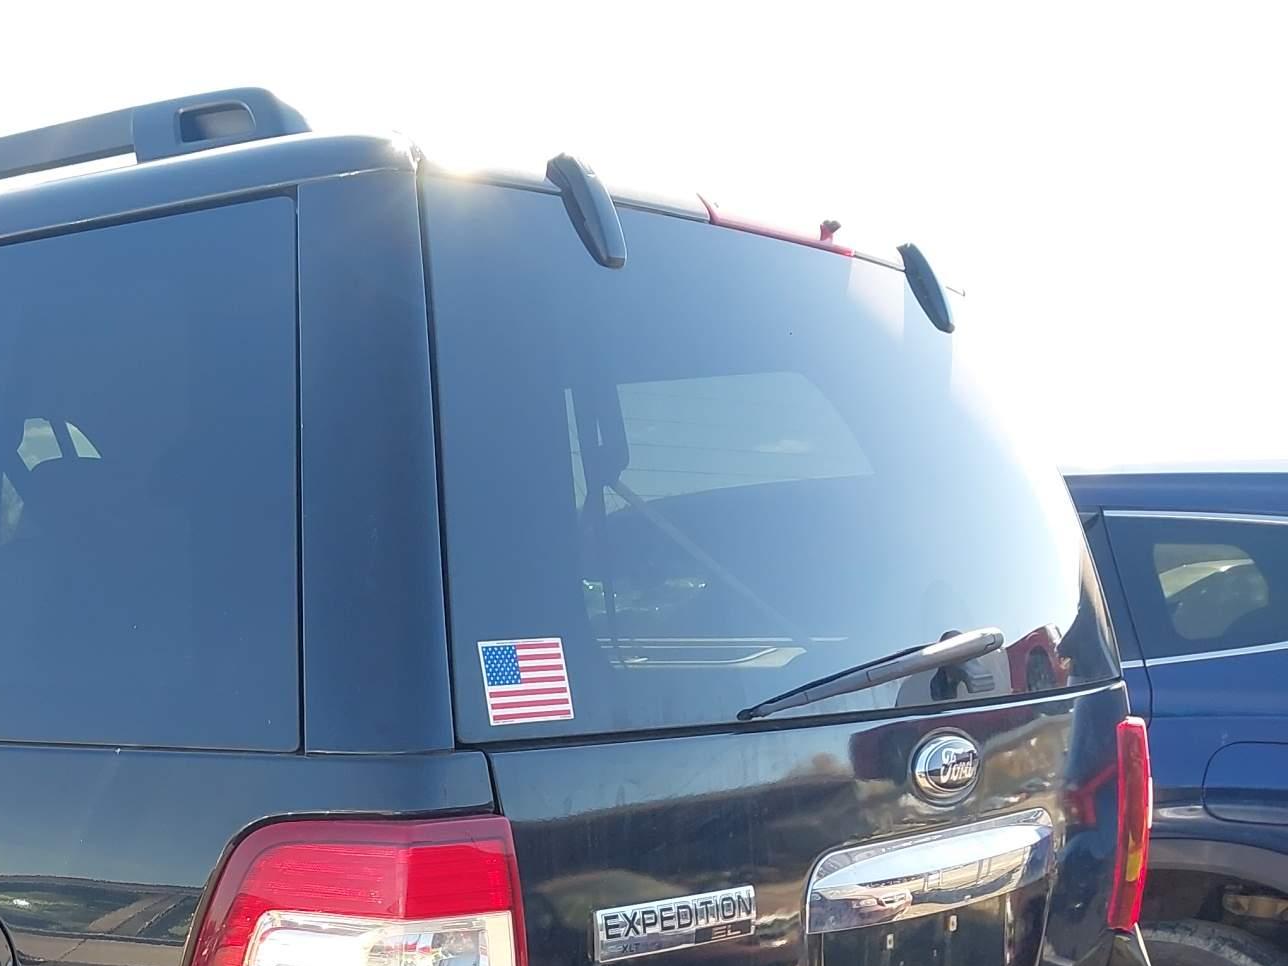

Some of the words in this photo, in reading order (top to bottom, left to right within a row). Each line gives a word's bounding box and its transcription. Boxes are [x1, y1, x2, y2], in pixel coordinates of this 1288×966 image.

[940, 748, 978, 784] Ford
[603, 892, 752, 938] EXPEDITION
[712, 924, 741, 939] EL
[622, 943, 640, 953] XLT
